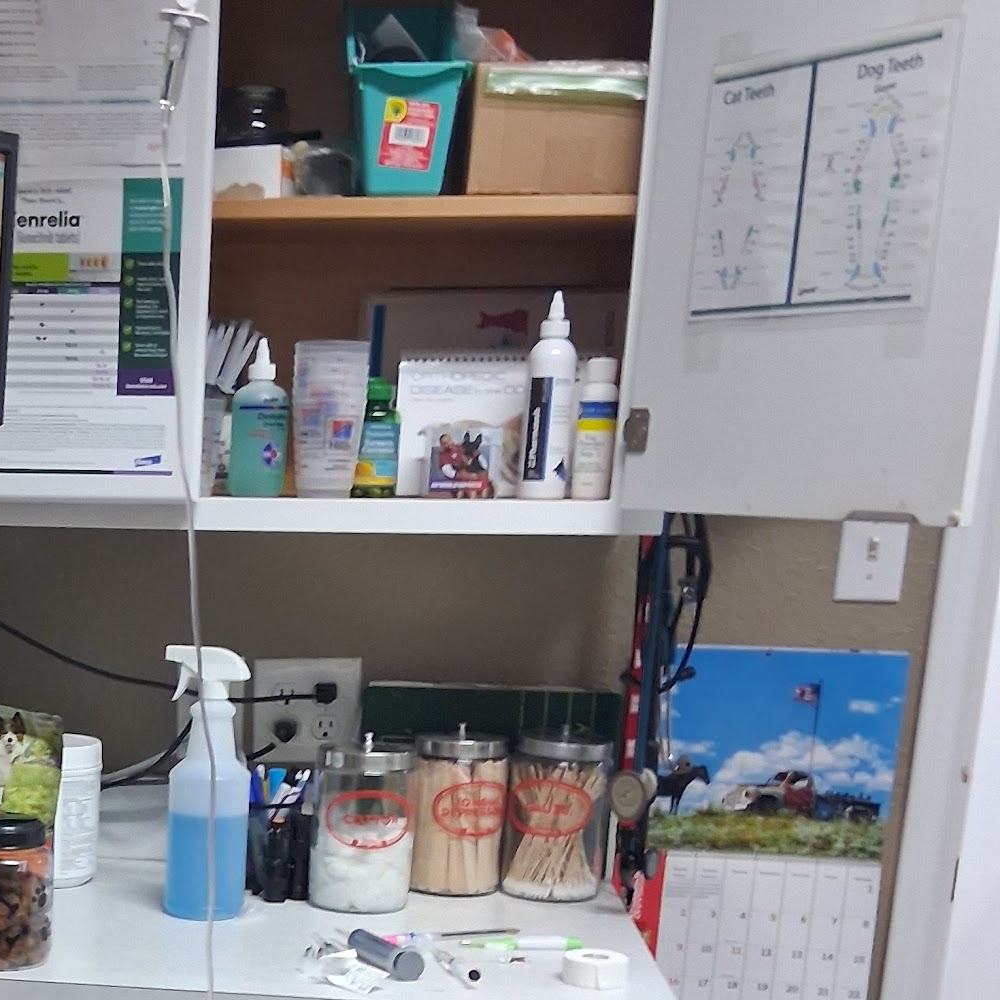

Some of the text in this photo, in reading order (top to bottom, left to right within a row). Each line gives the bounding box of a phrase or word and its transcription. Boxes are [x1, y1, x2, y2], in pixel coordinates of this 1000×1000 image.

[857, 52, 924, 81] Dog Teeth
[724, 84, 776, 105] Cat Teeth
[15, 210, 81, 228] enrelia
